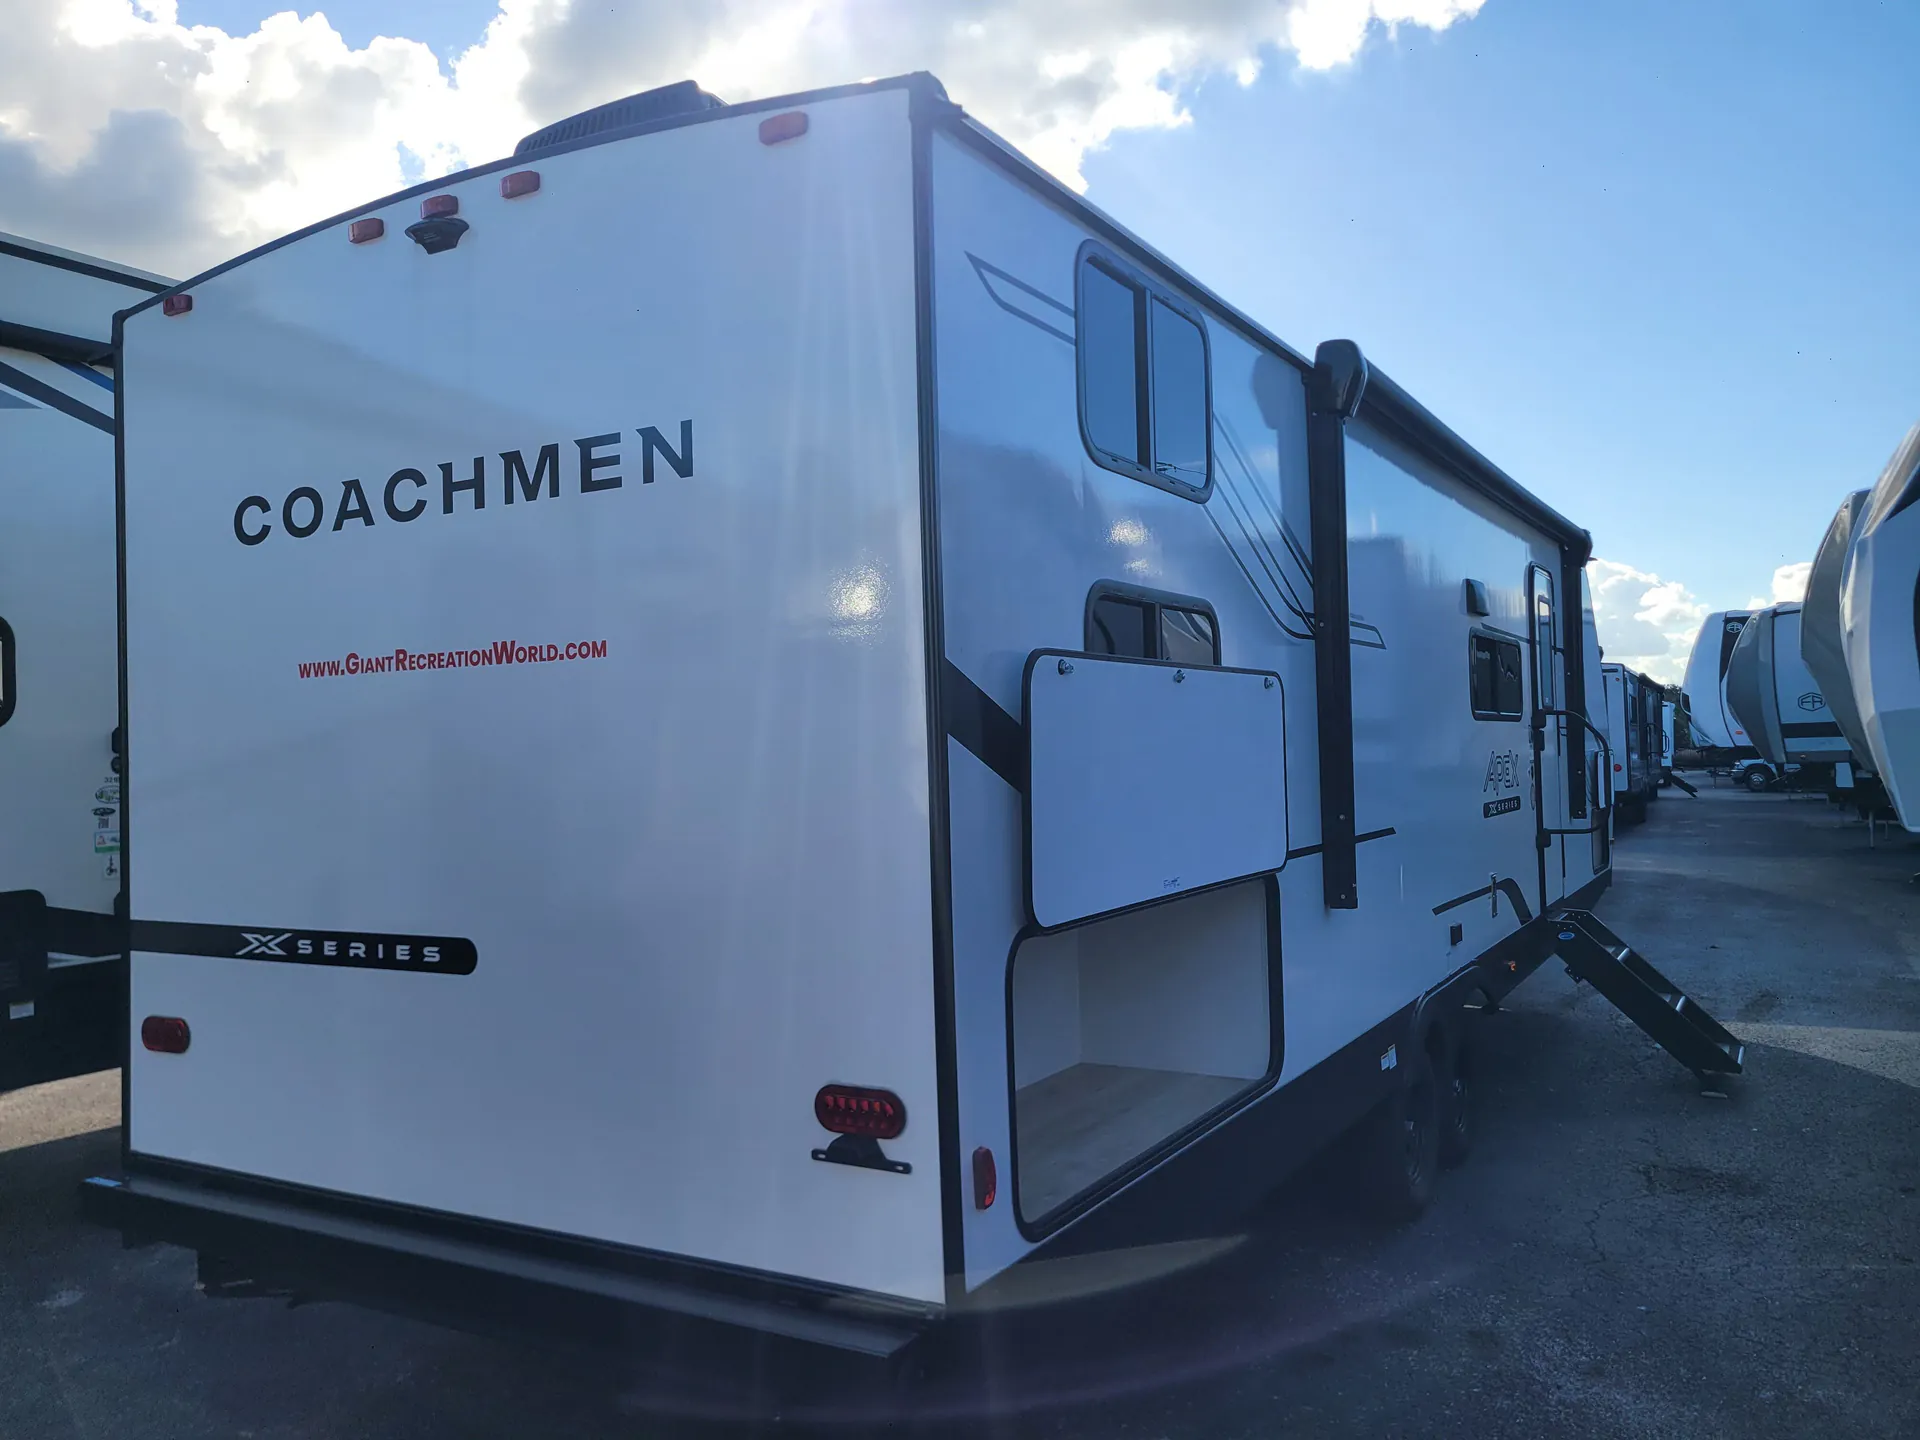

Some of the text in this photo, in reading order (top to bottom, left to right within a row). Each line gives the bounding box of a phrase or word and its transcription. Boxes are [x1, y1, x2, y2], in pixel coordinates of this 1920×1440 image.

[233, 419, 694, 546] COACHMEN
[1483, 749, 1519, 796] APEX
[1497, 800, 1518, 811] SERIES
[297, 939, 441, 963] SERIES
